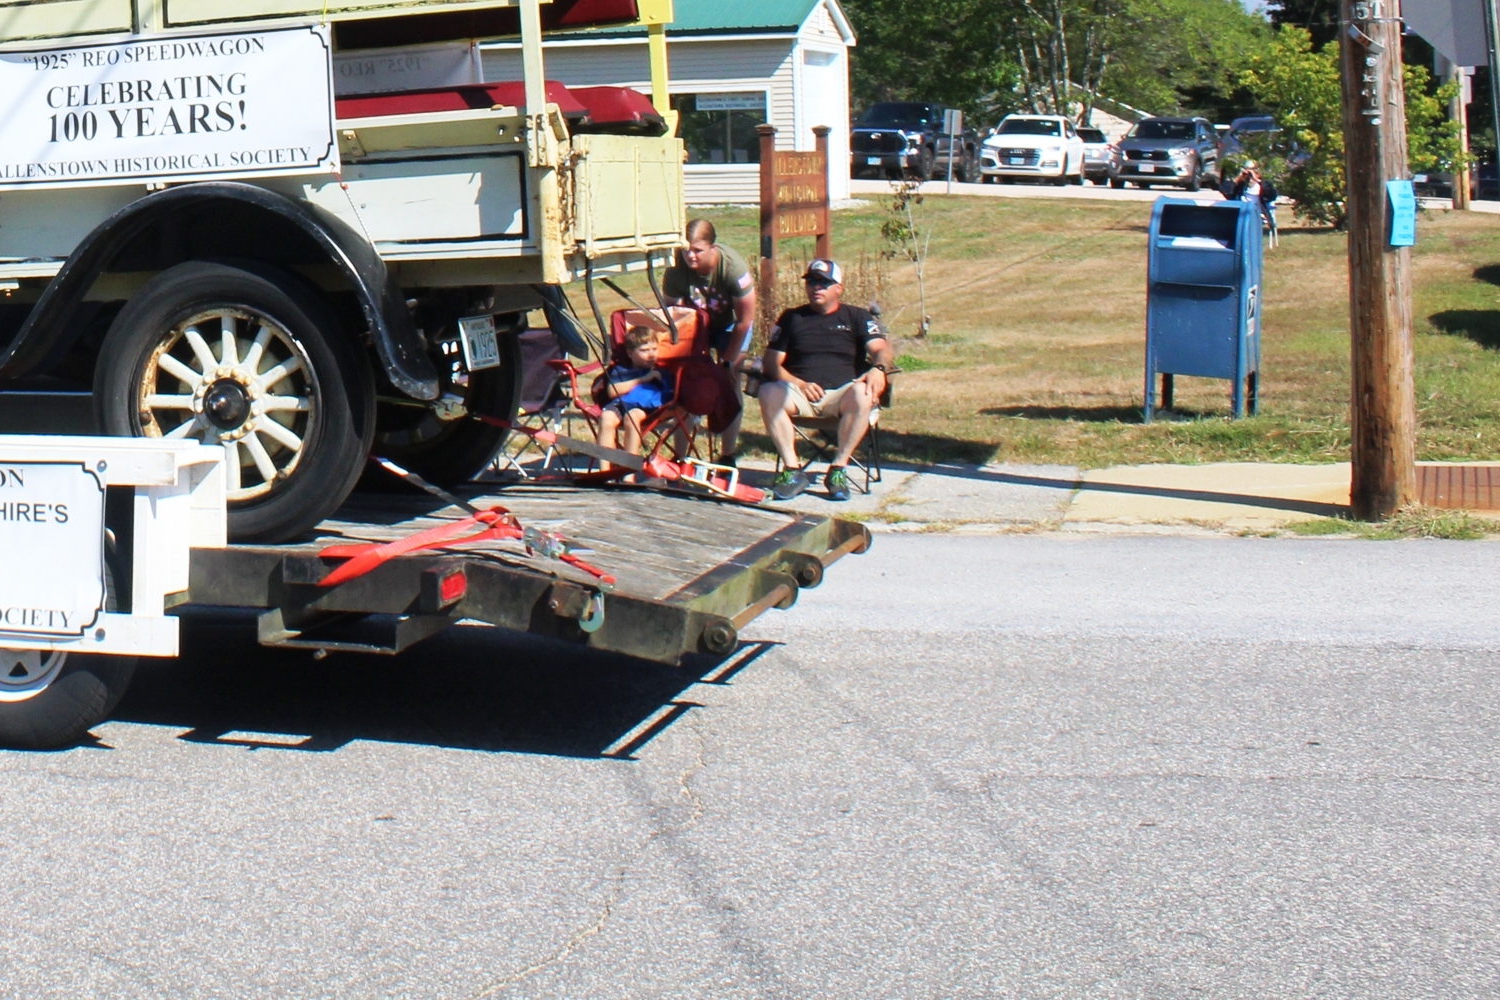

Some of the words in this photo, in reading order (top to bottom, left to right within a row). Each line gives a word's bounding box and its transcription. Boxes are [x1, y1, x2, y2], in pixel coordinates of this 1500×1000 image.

[23, 52, 77, 72] “1925”
[82, 49, 120, 68] REO
[124, 36, 266, 64] SPEEDWAGON
[46, 71, 247, 109] CELEBRATING
[48, 110, 98, 144] 100
[106, 99, 248, 139] YEARS!
[113, 152, 226, 174] HISTORICAL
[230, 146, 312, 167] SOCIETY
